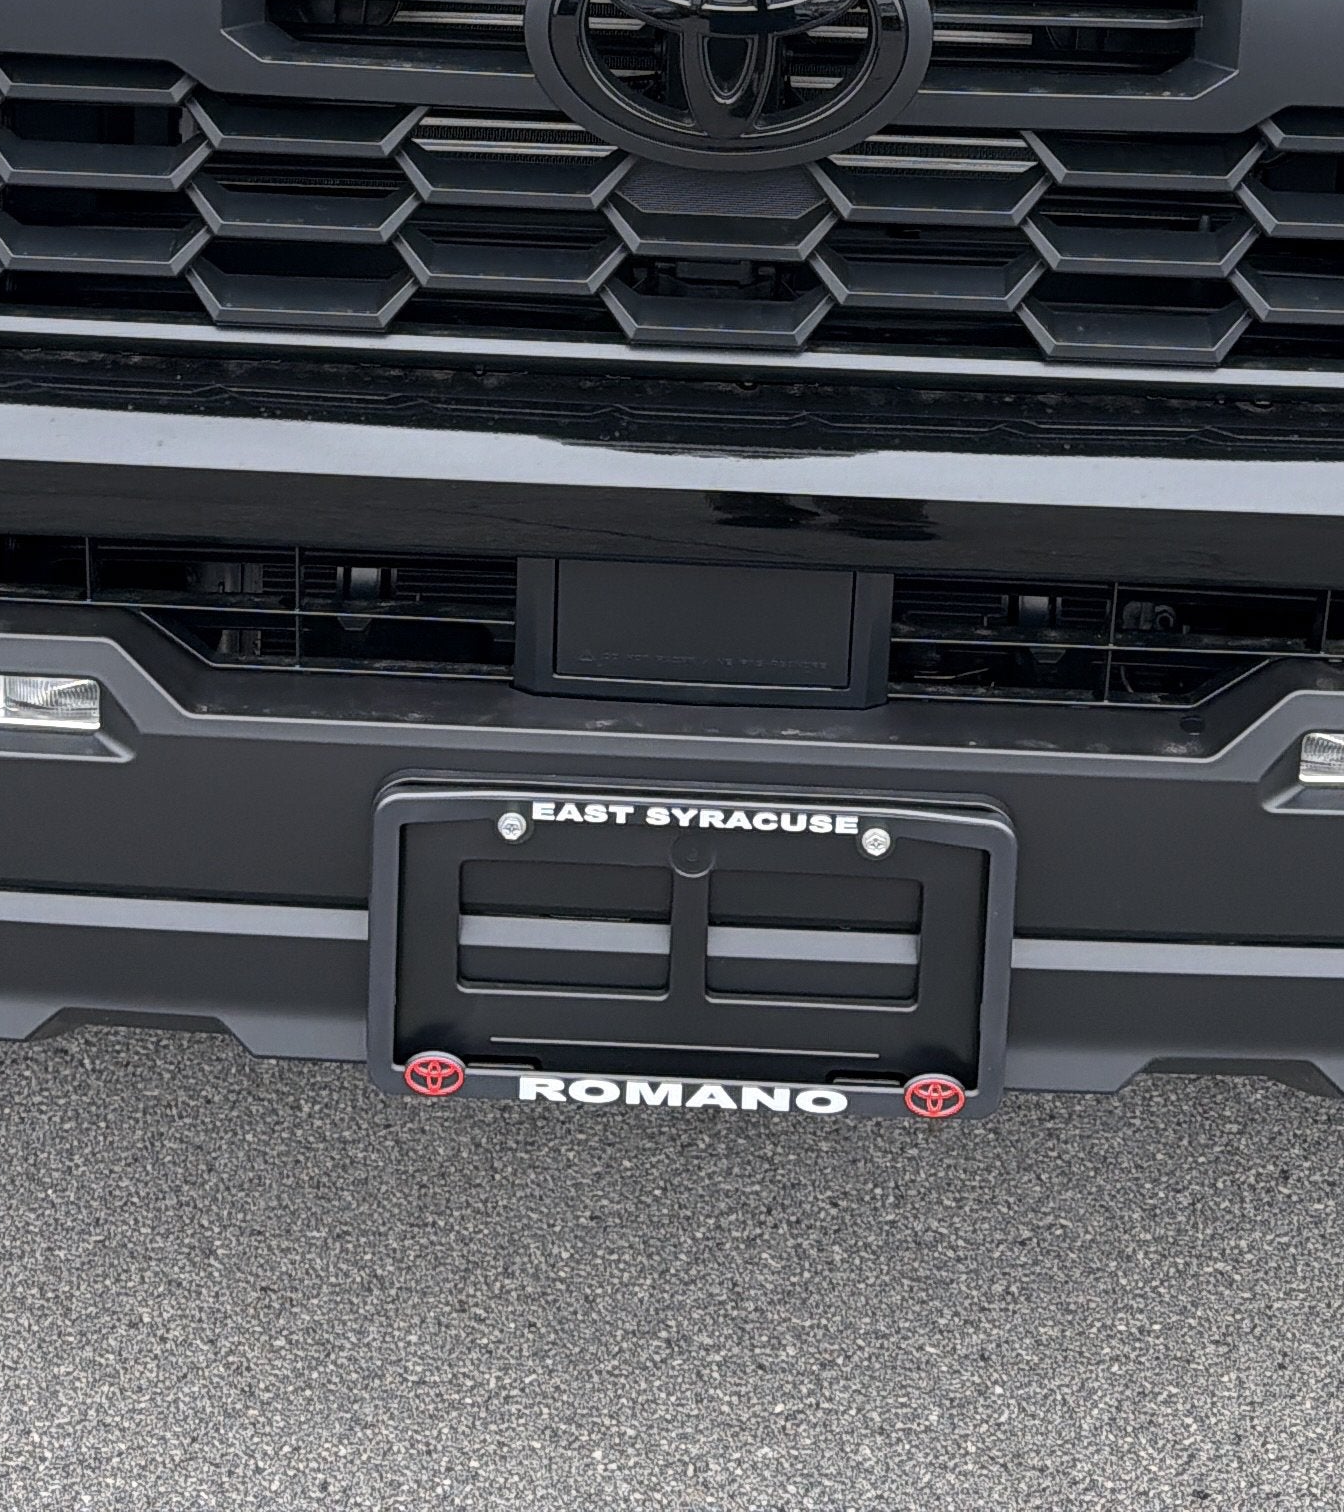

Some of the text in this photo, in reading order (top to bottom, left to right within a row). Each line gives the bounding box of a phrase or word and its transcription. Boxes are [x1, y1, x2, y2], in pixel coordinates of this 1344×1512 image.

[532, 801, 859, 835] EAST SYRACUSE
[519, 1076, 848, 1114] ROMANO
